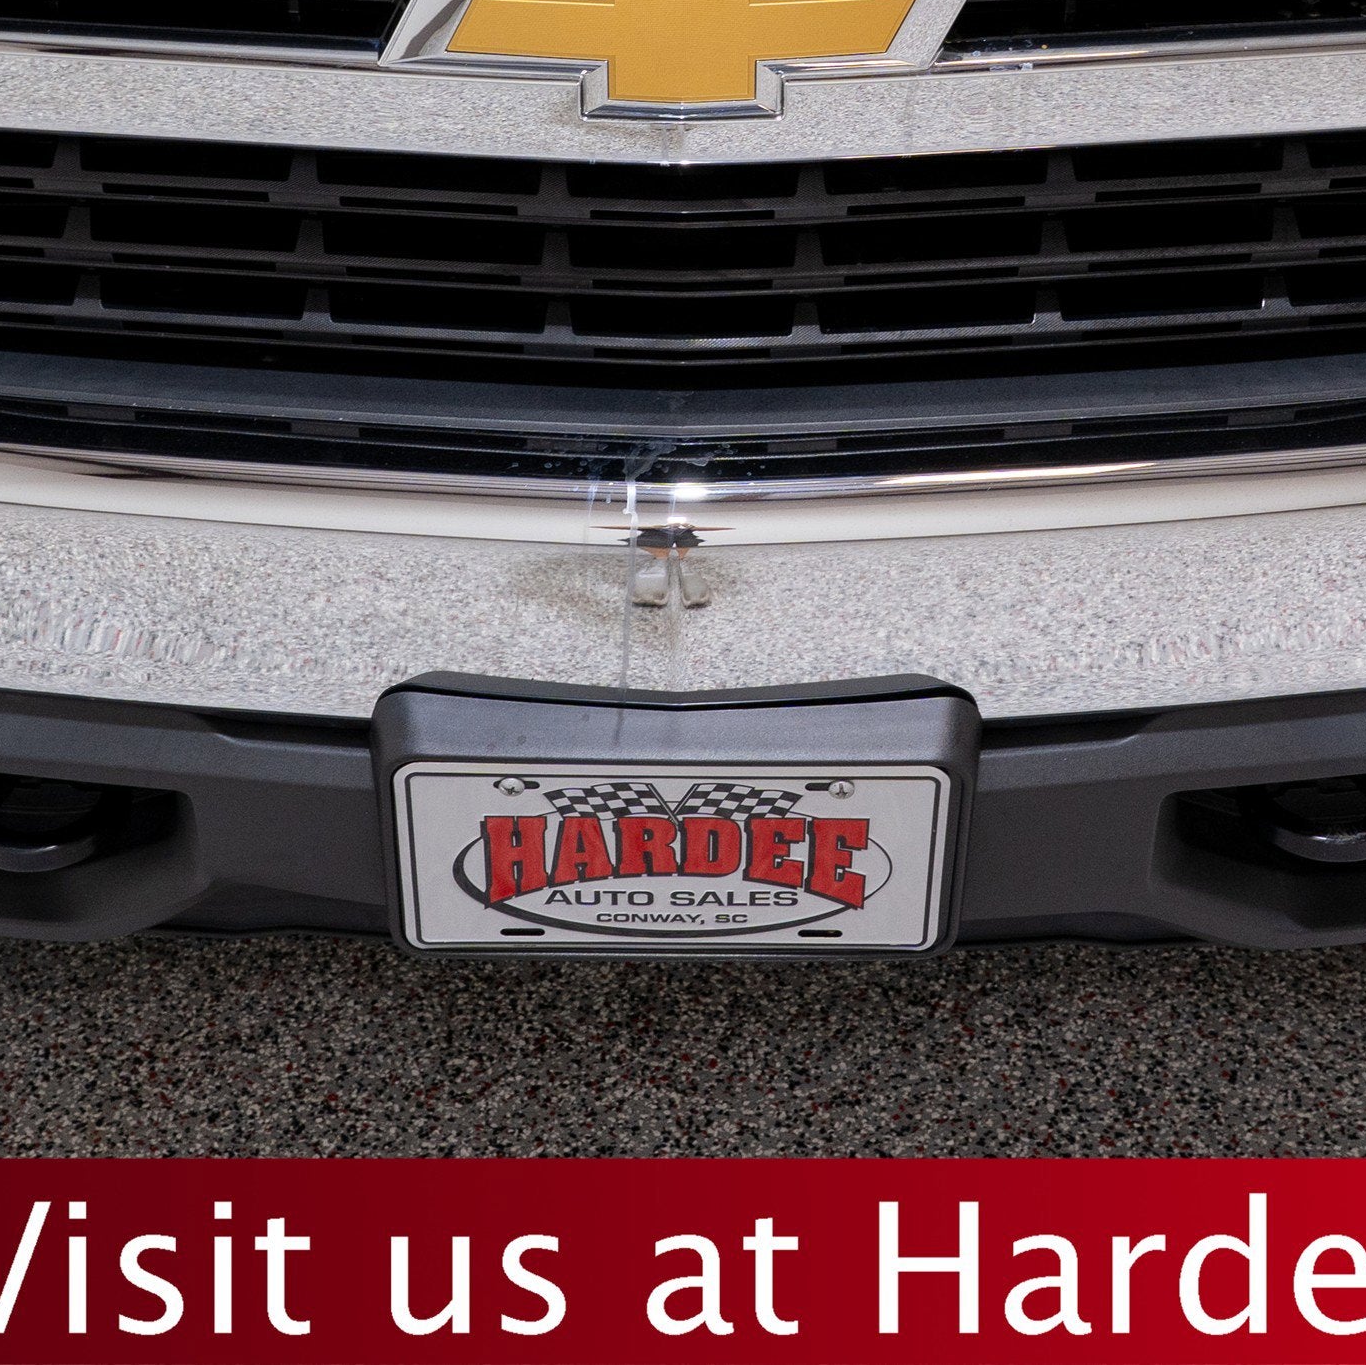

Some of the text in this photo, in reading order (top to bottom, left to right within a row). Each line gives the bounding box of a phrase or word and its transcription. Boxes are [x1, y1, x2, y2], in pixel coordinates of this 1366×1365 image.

[481, 816, 869, 910] HARDEE
[544, 889, 799, 908] AUTO SALES
[596, 913, 748, 926] CONWAY, SC
